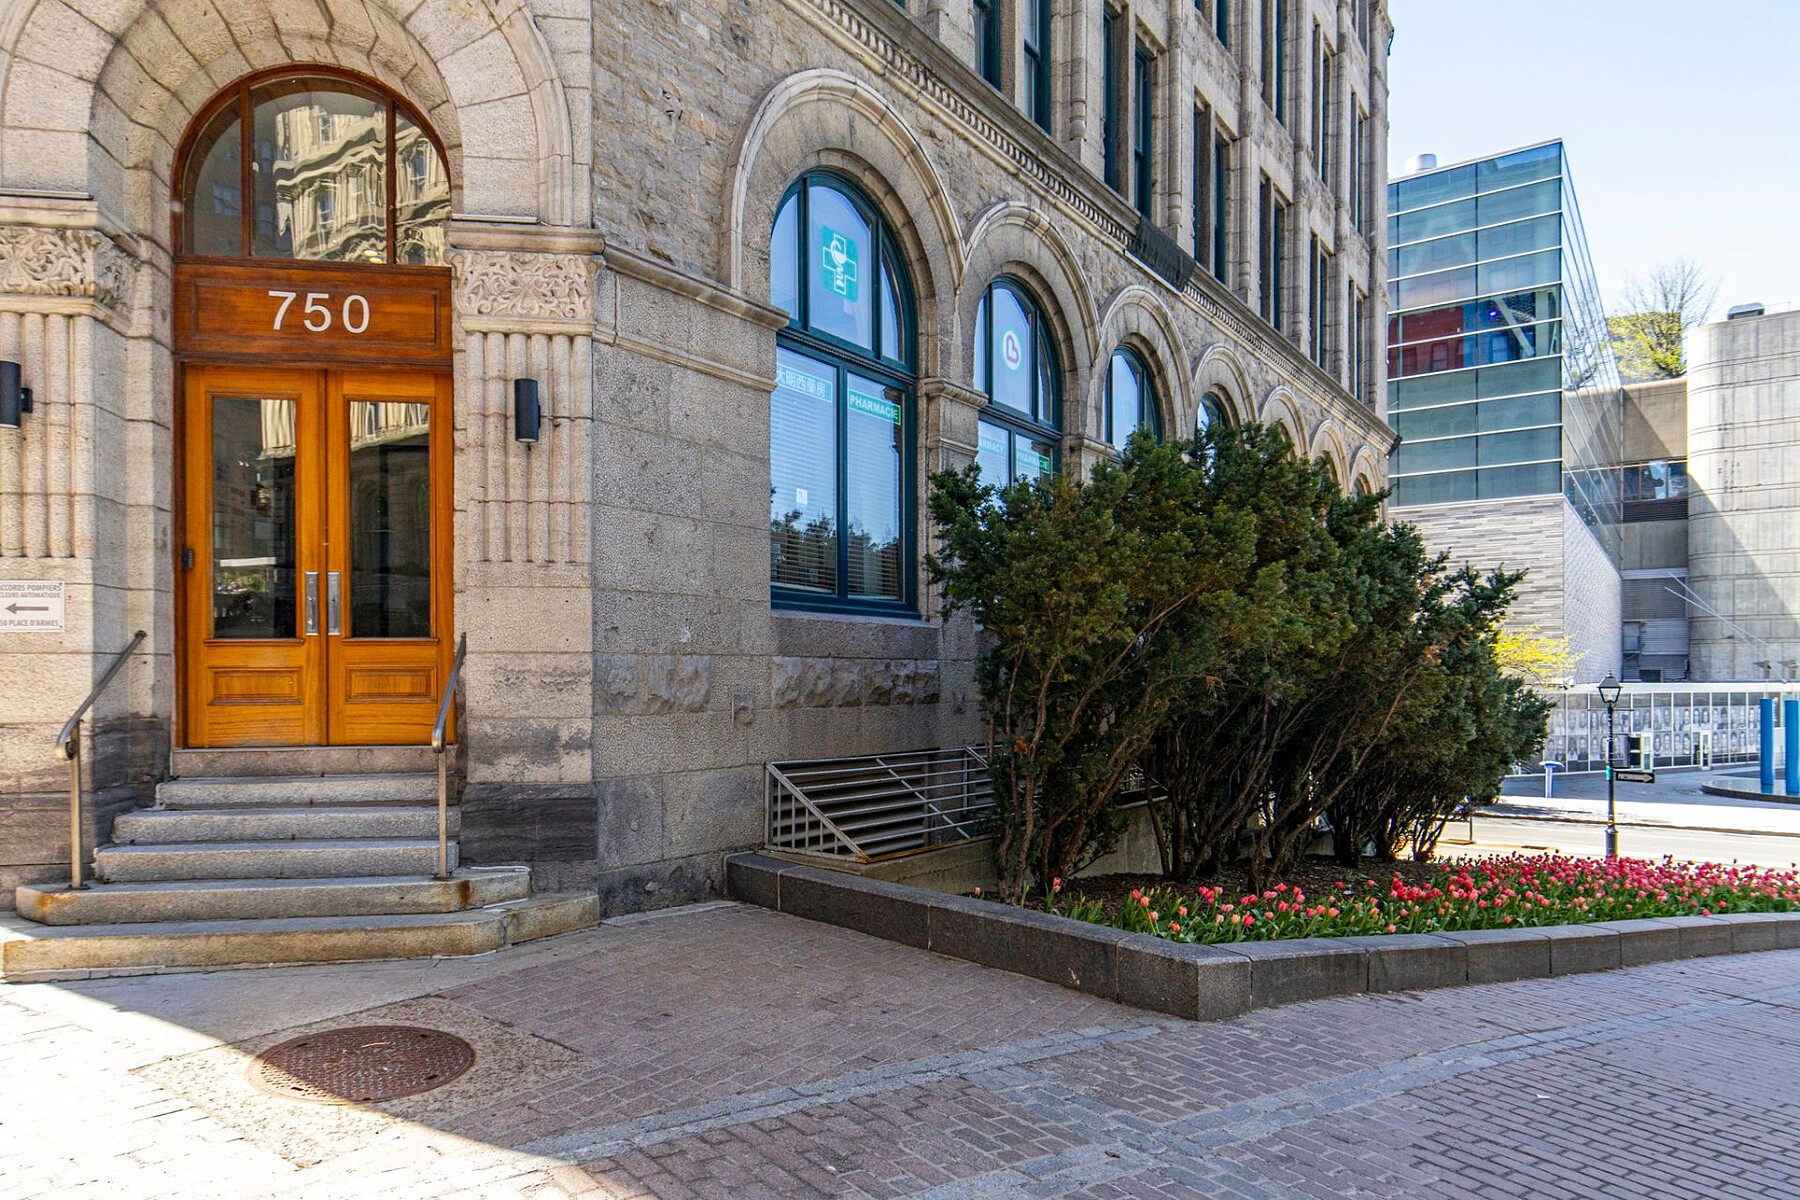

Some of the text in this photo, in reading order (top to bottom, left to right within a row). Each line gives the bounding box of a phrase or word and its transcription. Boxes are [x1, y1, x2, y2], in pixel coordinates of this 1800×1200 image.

[268, 290, 370, 334] 750
[850, 395, 898, 419] PHARMACIE
[27, 584, 61, 592] POMPIERS
[9, 619, 28, 627] PLACE
[30, 619, 59, 627] D'ARMES
